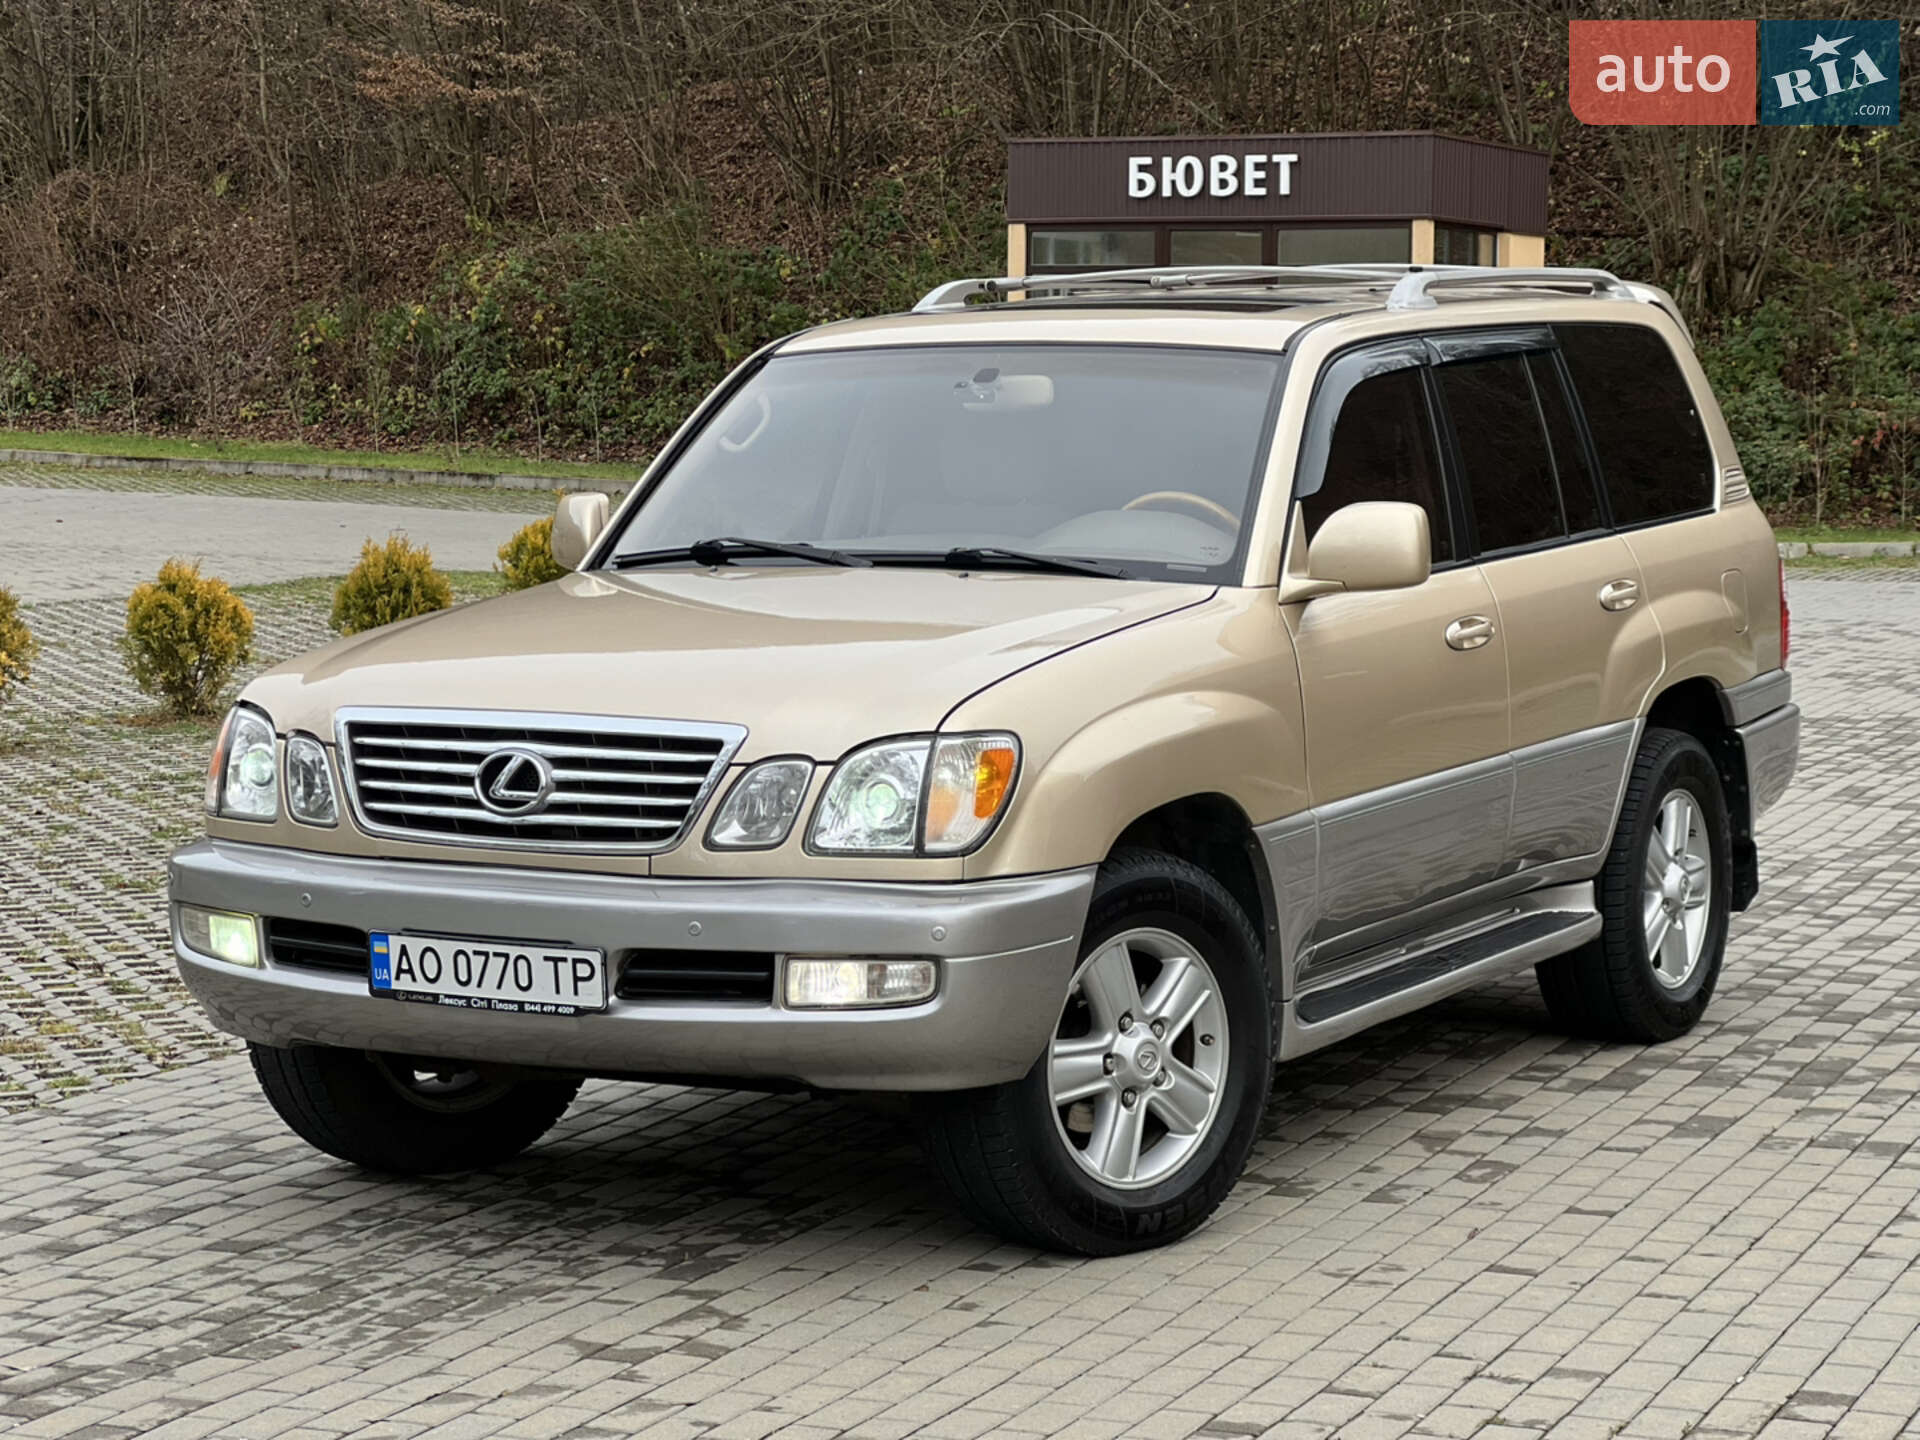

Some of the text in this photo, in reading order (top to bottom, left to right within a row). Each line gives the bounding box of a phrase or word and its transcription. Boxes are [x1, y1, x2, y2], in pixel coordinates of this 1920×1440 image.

[1128, 154, 1299, 198] БЮВЕТ
[375, 968, 390, 981] UA
[453, 949, 533, 992] 0770
